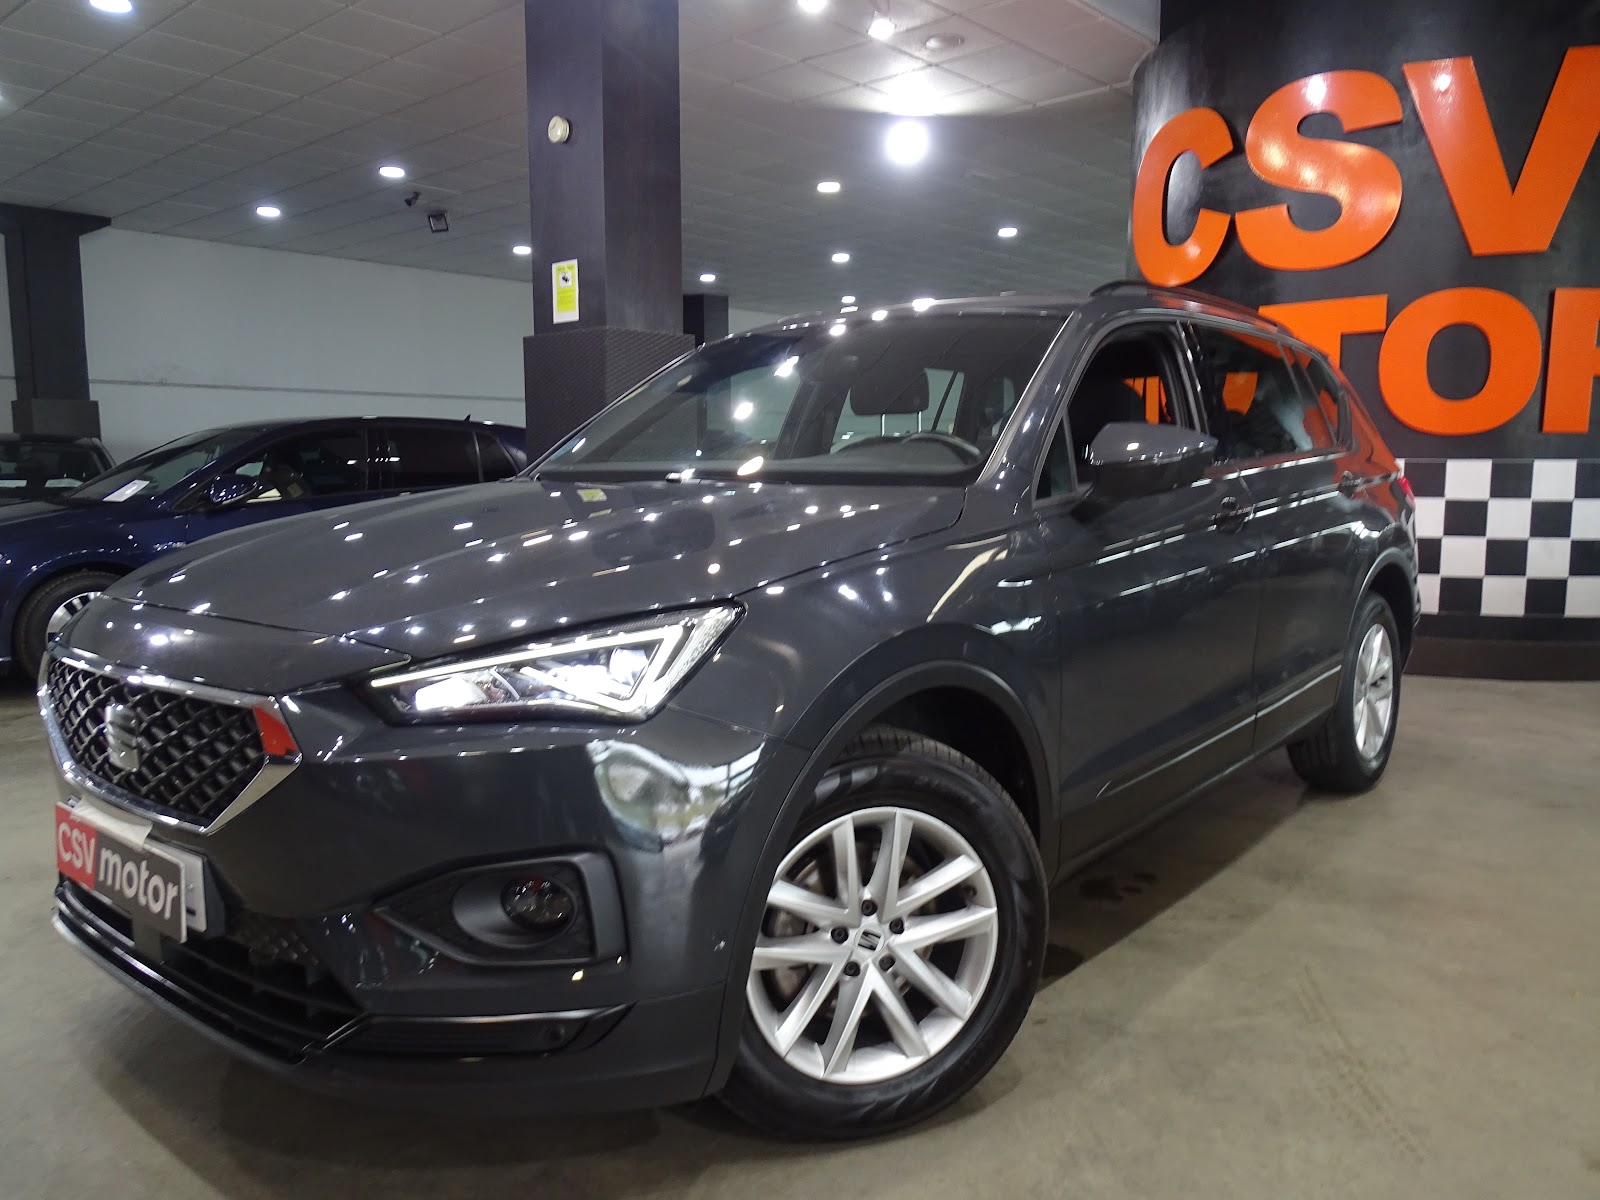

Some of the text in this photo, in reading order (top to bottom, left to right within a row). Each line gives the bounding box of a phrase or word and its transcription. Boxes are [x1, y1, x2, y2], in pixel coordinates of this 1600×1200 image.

[1132, 45, 1600, 288] CSV
[57, 821, 179, 921] CSV motor
